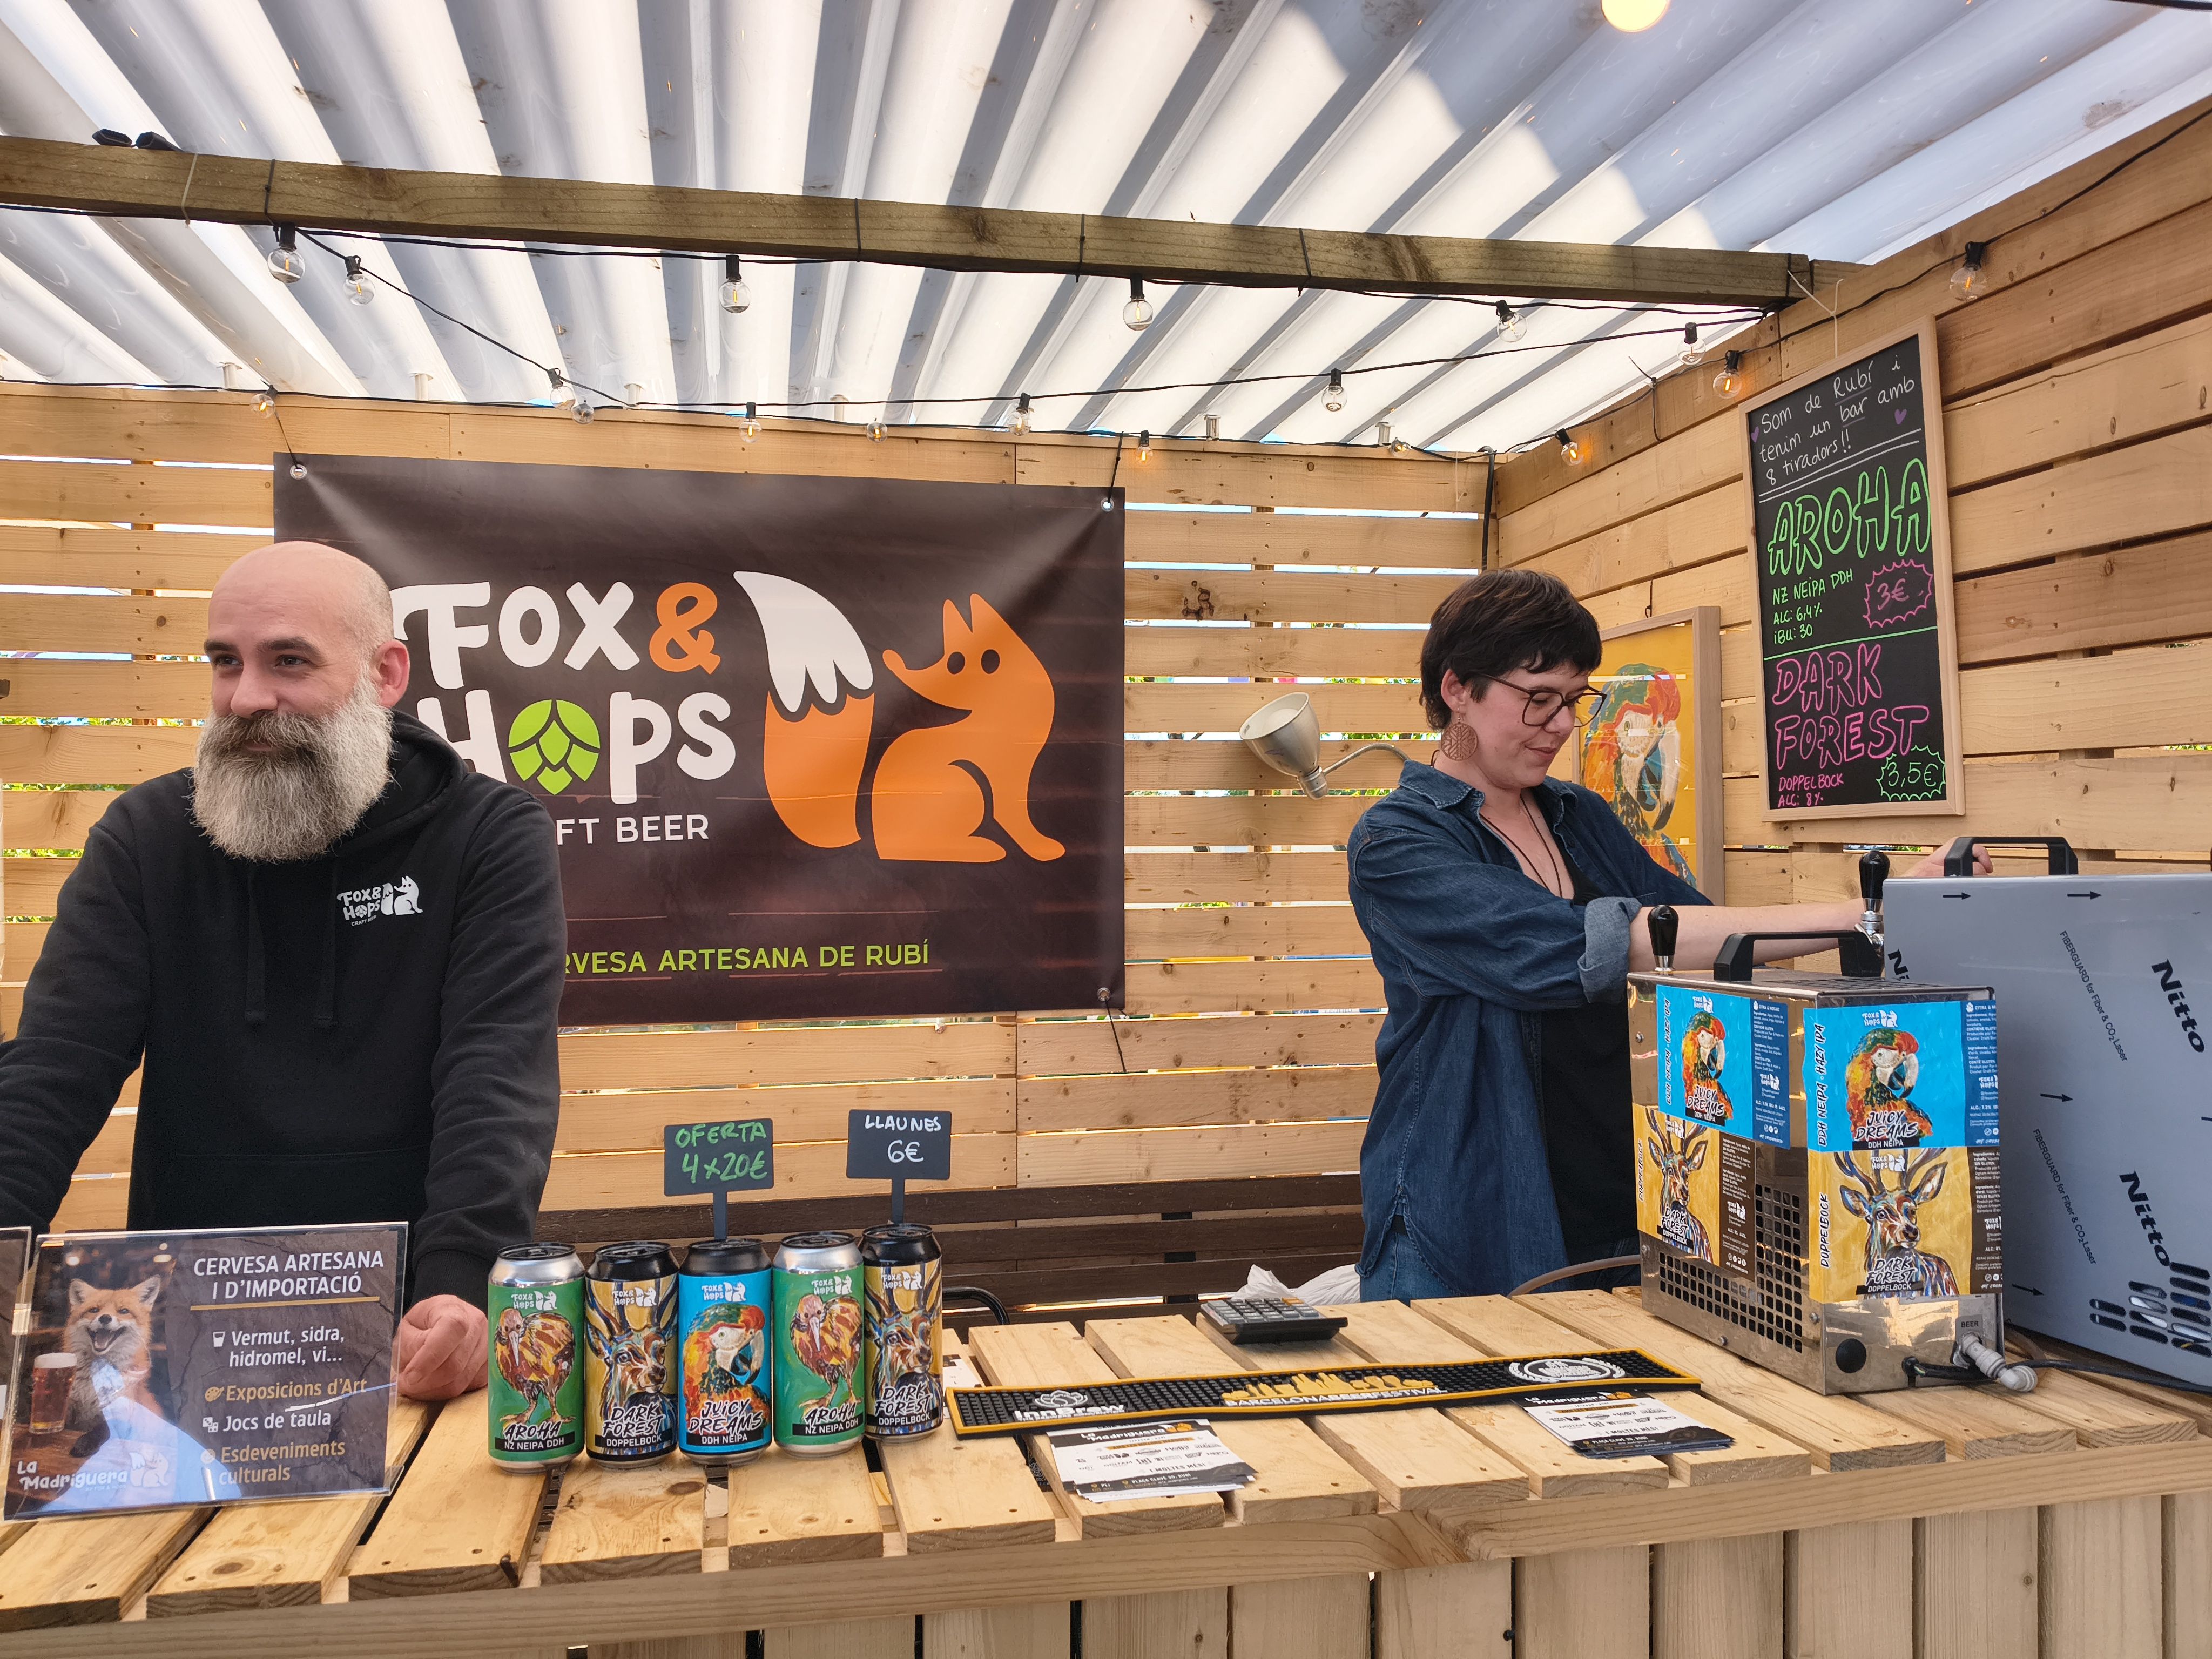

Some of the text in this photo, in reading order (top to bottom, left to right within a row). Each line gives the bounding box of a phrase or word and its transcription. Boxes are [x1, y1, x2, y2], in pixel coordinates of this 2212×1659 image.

[1762, 355, 1900, 433] Som de Rubí i
[1760, 376, 1914, 463] tenim un bar amb
[1766, 429, 1851, 485] 8 tiradors!!
[1768, 458, 1931, 575] AROHA
[1773, 586, 1788, 605] NZ
[1830, 568, 1853, 589] DDH
[1877, 578, 1910, 610] 3€
[1773, 602, 1823, 624] ALC: 6,4%
[1799, 624, 1813, 638] 30
[1772, 643, 1883, 715] DARK
[1775, 705, 1930, 770] FOREST
[1887, 761, 1938, 787] 3,5€
[1778, 792, 1824, 807] ALC: 8%
[616, 814, 709, 844] BEER
[351, 918, 367, 926] CRAFT
[658, 946, 808, 972] ARTESANA
[820, 945, 855, 967] DE
[866, 939, 929, 966] RUBÍ
[2060, 930, 2089, 983] FIBERGUARD
[2086, 983, 2094, 994] for
[2092, 994, 2105, 1014] Fiber
[2113, 1038, 2127, 1061] Laser
[2151, 959, 2204, 1053] Nitto
[1814, 1022, 1828, 1147] DDH NEIPA HAZY IPA
[1687, 1096, 1725, 1116] DREAMS
[865, 1115, 942, 1132] LLAUNES
[1856, 1122, 1918, 1141] DREAMS
[675, 1122, 767, 1148] OFERTA
[1868, 1139, 1904, 1149] DDH NEIPA
[887, 1139, 924, 1163] 6€
[2033, 1129, 2060, 1183] FIBERGUARD
[2057, 1183, 2066, 1195] for
[1665, 1206, 1687, 1225] DARK
[2061, 1195, 2075, 1215] Fiber
[1662, 1215, 1689, 1238] FOREST
[2071, 1216, 2078, 1224] &
[2119, 1170, 2170, 1266] Nitto
[1819, 1192, 1831, 1269] DOPPELBOCK
[194, 1250, 383, 1276] CERVESA ARTESANA
[1874, 1255, 1913, 1271] DARK
[2082, 1240, 2096, 1265] Laser
[1866, 1268, 1917, 1286] FOREST
[1868, 1283, 1911, 1292] DOPPELBOCK
[213, 1282, 218, 1299] I
[232, 1326, 344, 1346] Vermut, sidra,
[230, 1348, 306, 1367] hidromel,
[227, 1381, 322, 1403] Exposicions
[883, 1382, 927, 1400] DARK
[611, 1402, 658, 1421] DARK
[805, 1402, 857, 1425] AROHA
[874, 1393, 933, 1418] FOREST
[223, 1410, 331, 1432] Jocs de taula
[603, 1414, 665, 1438] FOREST
[689, 1411, 763, 1436] DREAMS
[805, 1419, 859, 1434] NZ NEIPA DDH
[879, 1412, 930, 1426] DOPPELBOCK
[504, 1421, 562, 1441] AROHA
[606, 1435, 662, 1447] DOPPELBOCK
[702, 1434, 748, 1444] DDH NEIPA
[221, 1440, 346, 1465] Esdeveniments
[504, 1438, 564, 1451] NZ NEIPA DDH
[17, 1460, 38, 1474] La
[219, 1465, 291, 1485] culturals
[20, 1470, 127, 1491] Madriguera
